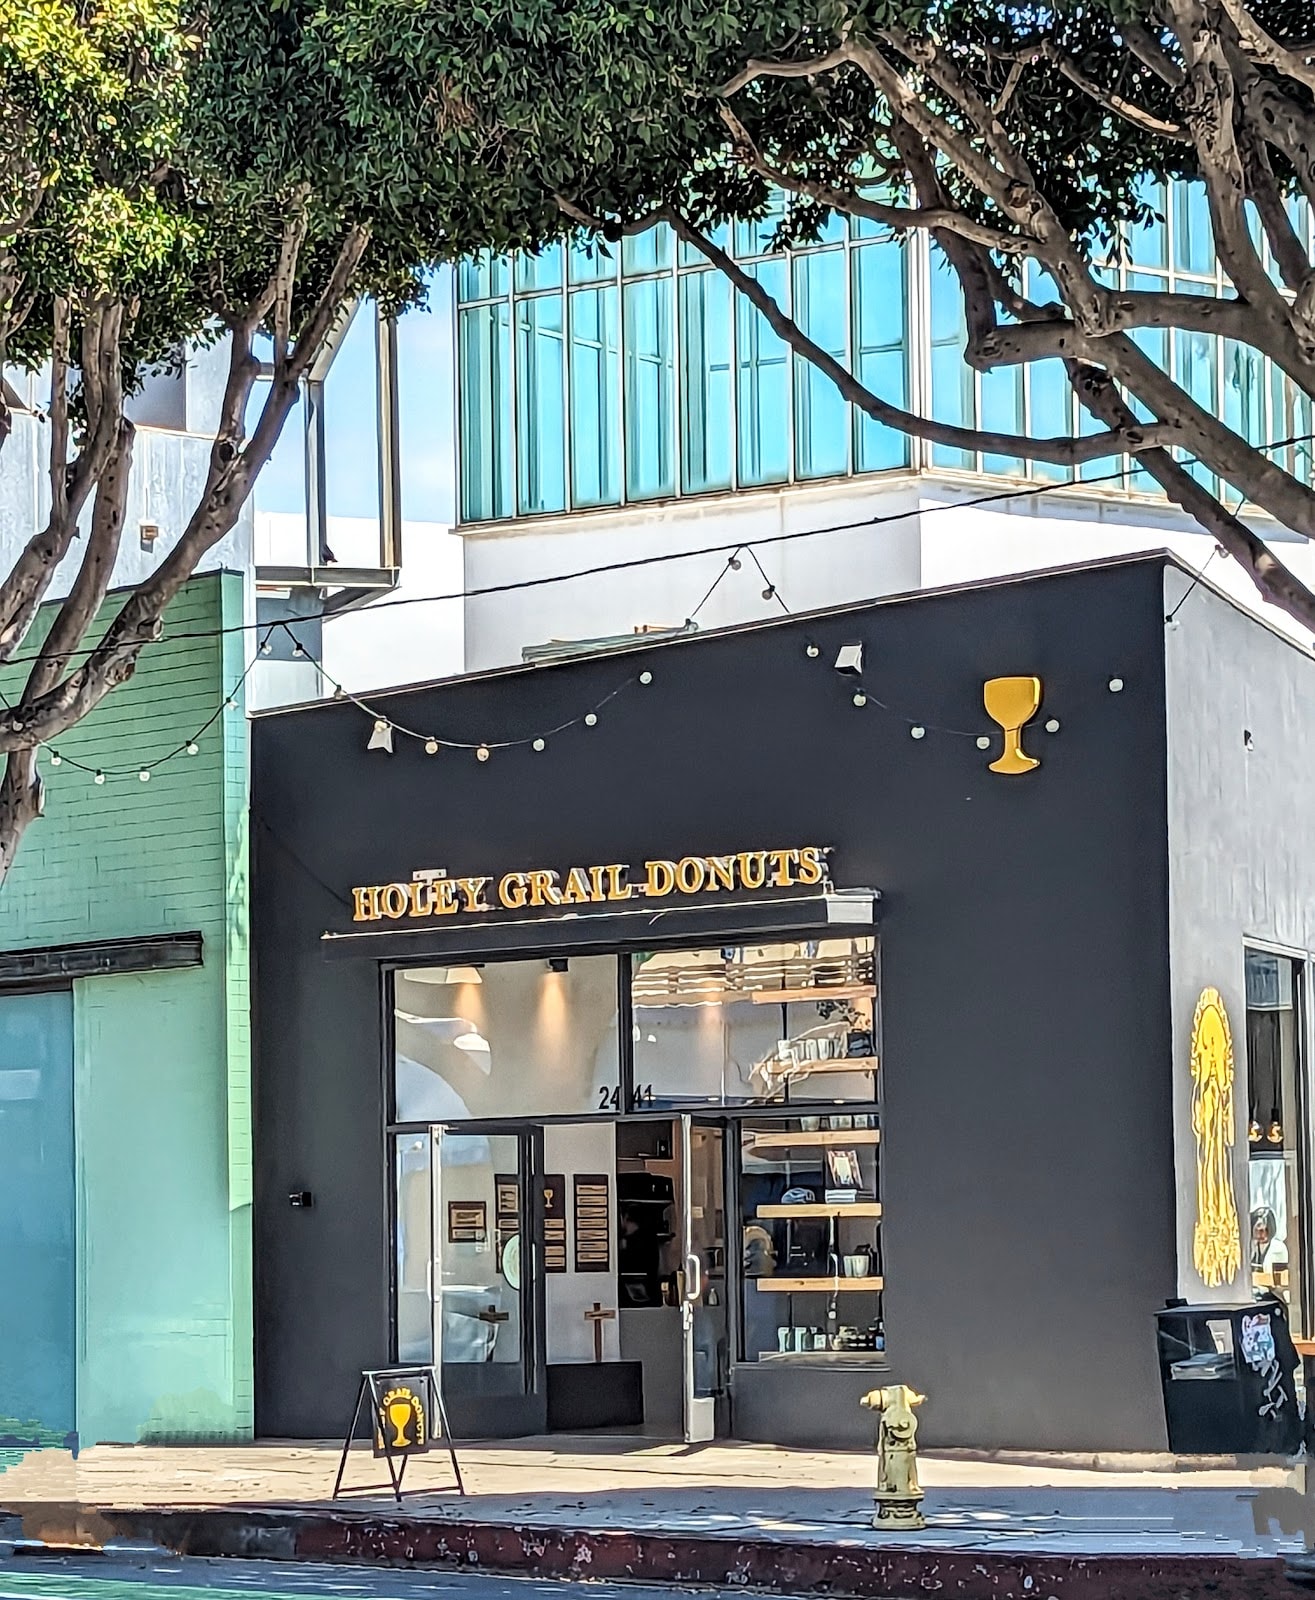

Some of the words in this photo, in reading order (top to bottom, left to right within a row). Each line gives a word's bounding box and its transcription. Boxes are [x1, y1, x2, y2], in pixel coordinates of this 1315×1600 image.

[352, 877, 489, 922] HOLEY
[499, 865, 632, 910] GRAIL
[645, 847, 824, 897] DONUTS
